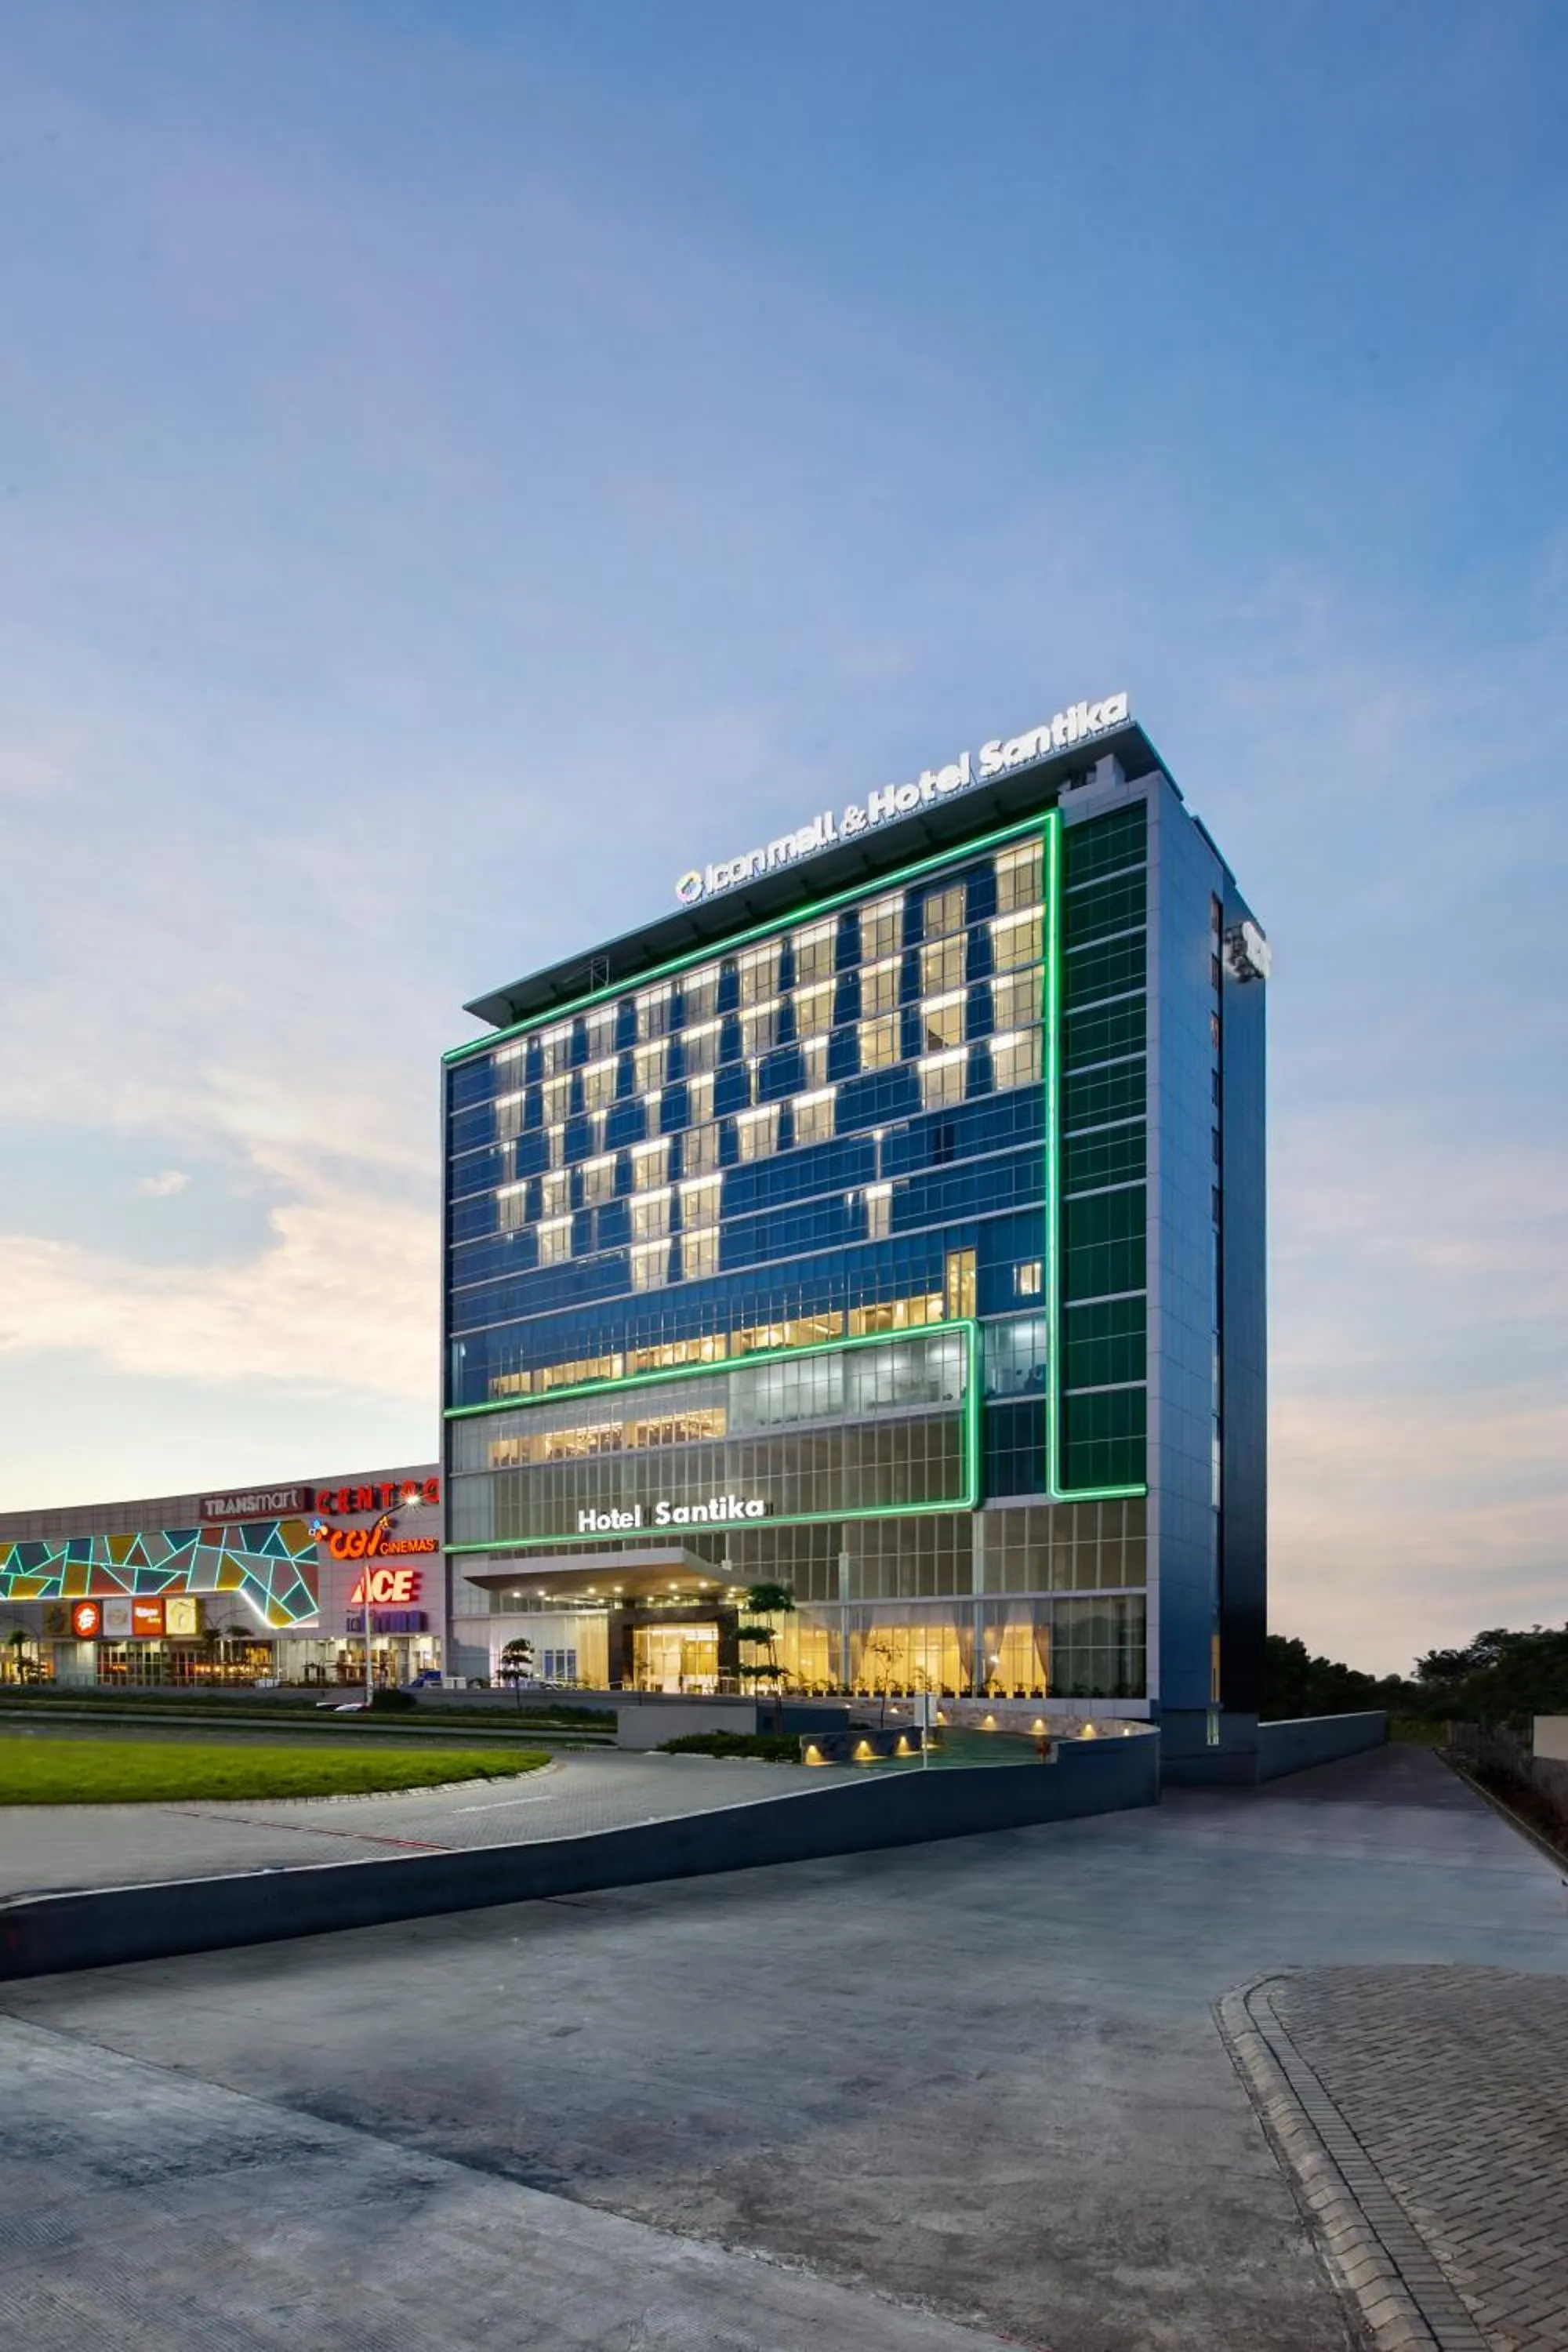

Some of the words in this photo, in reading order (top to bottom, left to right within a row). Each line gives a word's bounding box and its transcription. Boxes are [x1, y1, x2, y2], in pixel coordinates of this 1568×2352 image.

[840, 804, 866, 837] &
[867, 752, 971, 823] Hotel
[979, 693, 1127, 776] Santika
[579, 1505, 641, 1532] Hotel
[655, 1494, 765, 1526] Santika
[330, 1526, 382, 1559] CGV
[380, 1539, 436, 1555] CINEMAS
[350, 1567, 414, 1603] ACE
